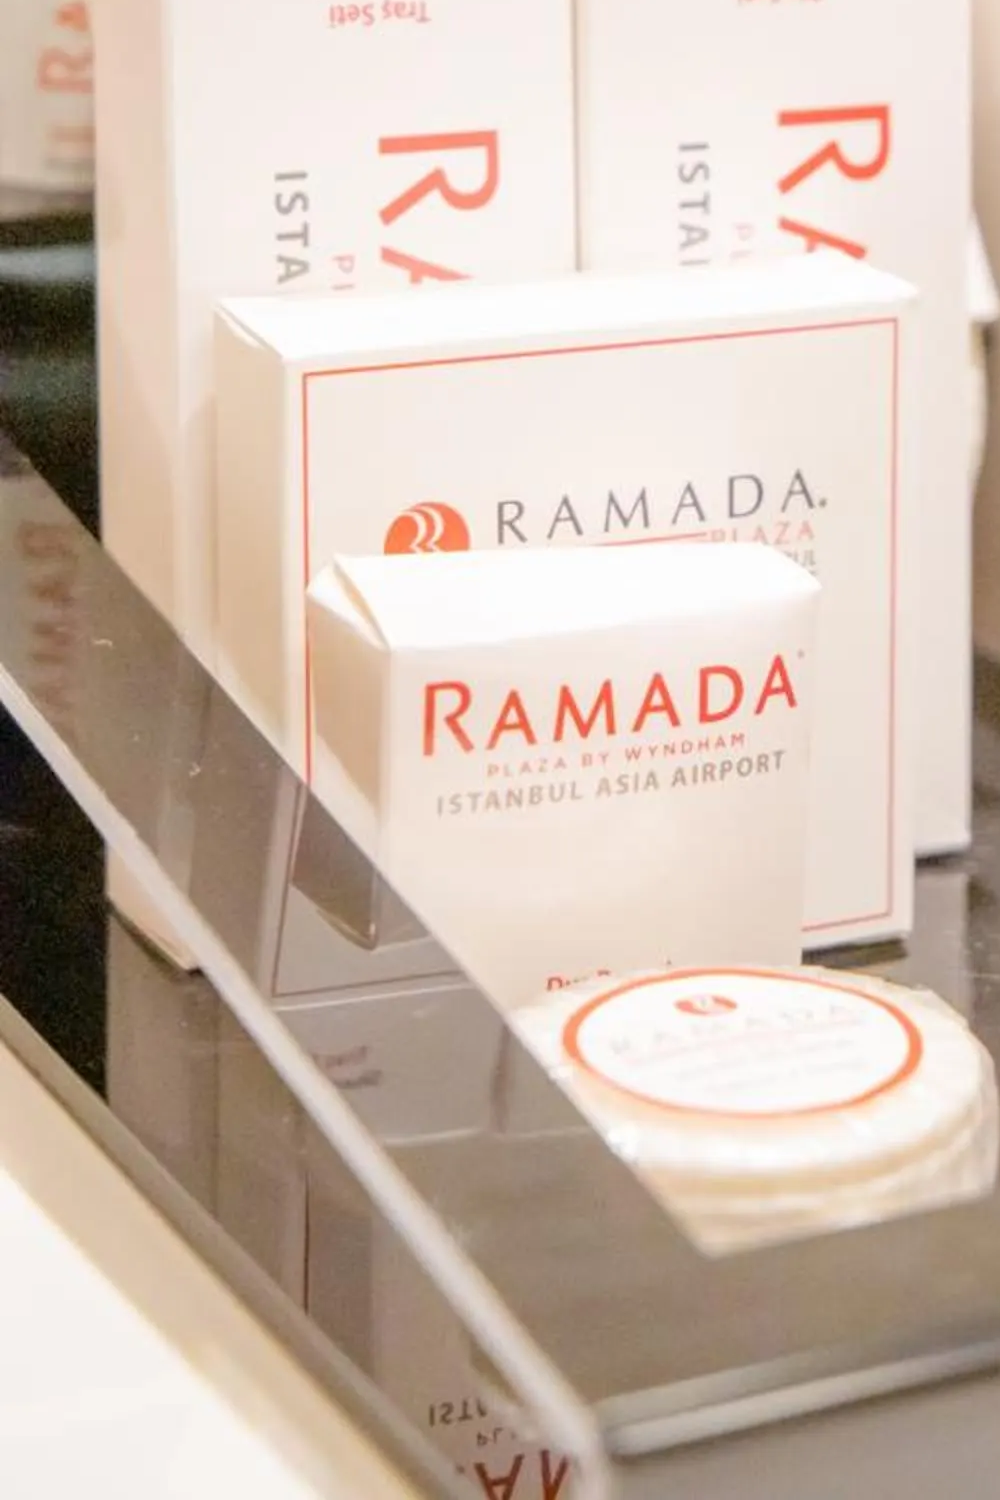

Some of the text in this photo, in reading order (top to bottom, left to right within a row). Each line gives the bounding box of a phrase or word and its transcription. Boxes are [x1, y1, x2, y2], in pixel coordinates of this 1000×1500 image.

[328, 2, 375, 29] Seti
[486, 732, 747, 778] PLAZA BY WYNDHAM
[436, 749, 789, 817] ISTANBUL ASIA AIRPORT
